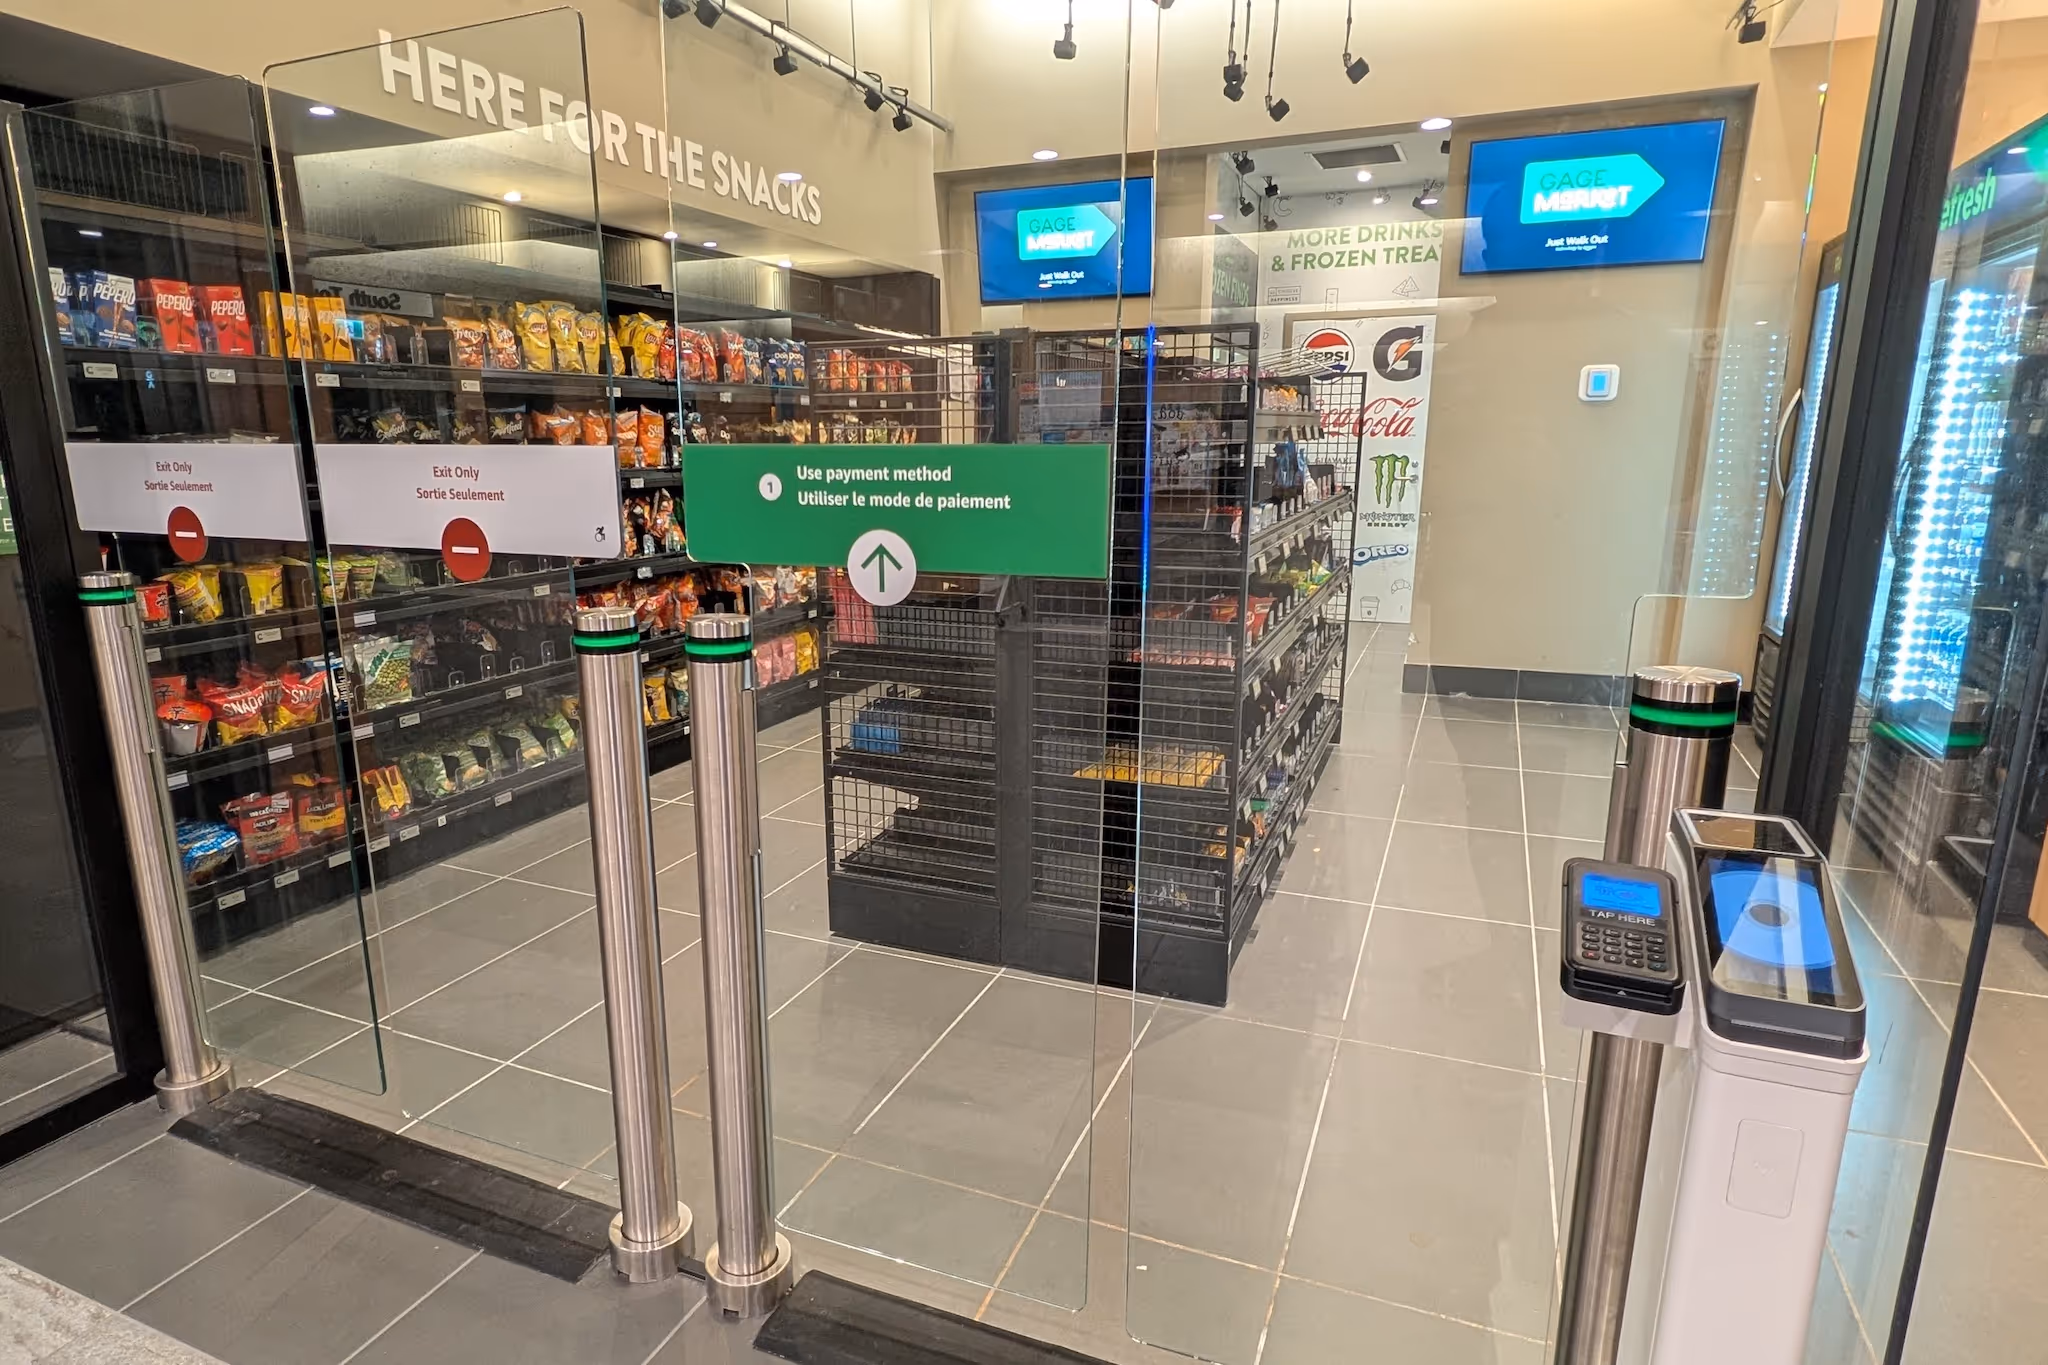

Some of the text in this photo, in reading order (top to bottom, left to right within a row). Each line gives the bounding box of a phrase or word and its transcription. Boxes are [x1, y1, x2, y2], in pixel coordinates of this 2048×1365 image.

[379, 28, 822, 226] HERE FOR THE SNACKS
[1539, 169, 1607, 190] GAGE
[1940, 168, 1997, 231] efresh
[1029, 217, 1076, 234] GAGE
[1286, 220, 1443, 249] MORE DRINKS
[1545, 234, 1608, 248] Just Walk Out
[1271, 255, 1285, 272] &
[1290, 250, 1376, 271] FROZEN
[1383, 245, 1442, 265] TREA
[93, 283, 136, 305] PEPERO
[156, 293, 193, 310] PEPERO
[211, 300, 246, 316] PEPERO
[156, 462, 192, 474] Exit Only
[433, 466, 480, 482] Exit Only
[797, 465, 952, 484] Use payment method
[144, 480, 214, 493] Sortie Seulement
[416, 488, 505, 502] Sortie Seulement
[766, 481, 774, 493] 1
[798, 491, 1011, 511] Utiliser le mode de paiement
[1353, 544, 1409, 567] OREO
[1589, 909, 1656, 927] TAP HERE
